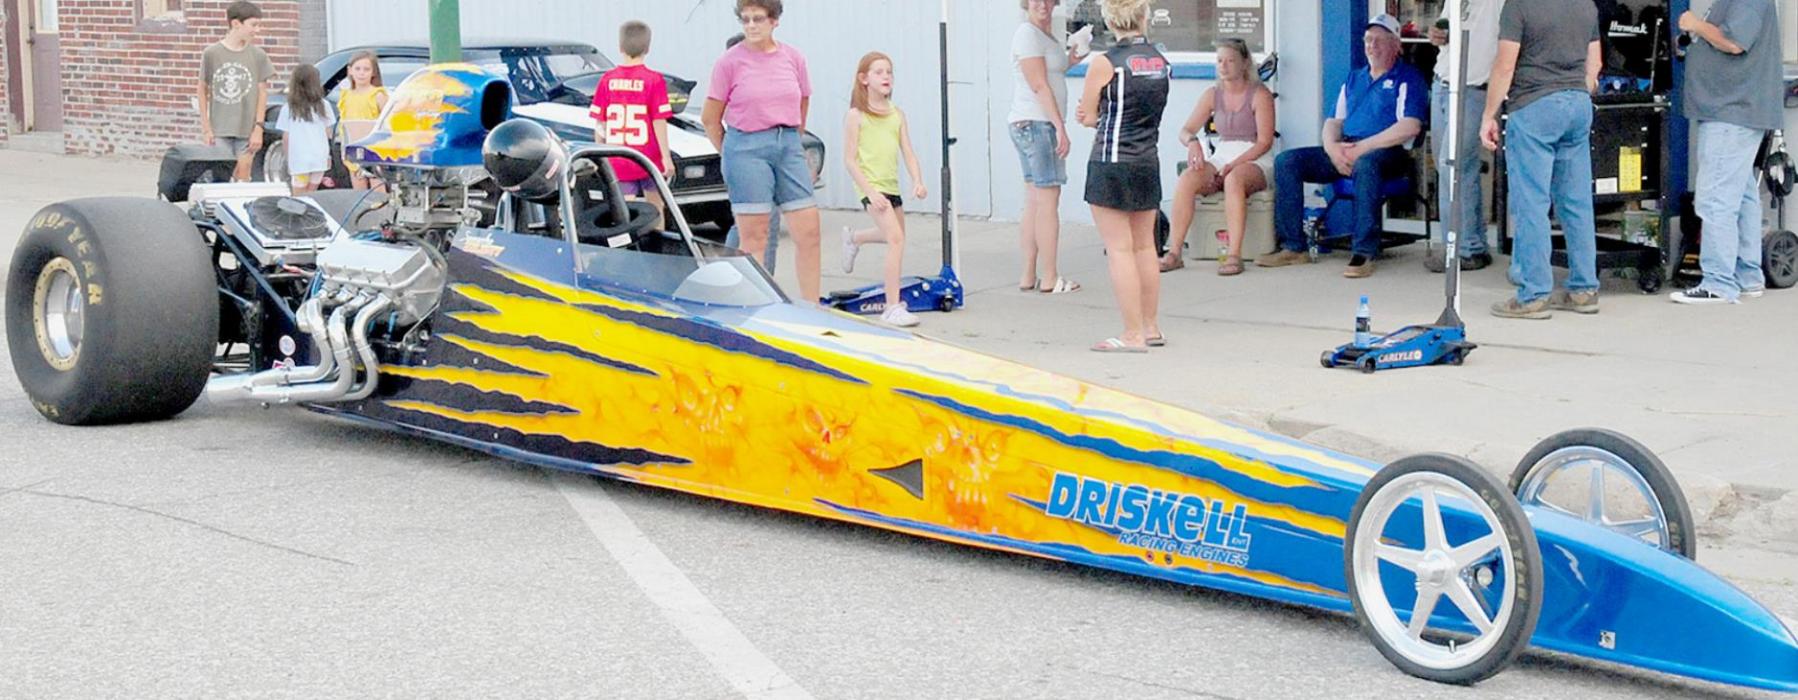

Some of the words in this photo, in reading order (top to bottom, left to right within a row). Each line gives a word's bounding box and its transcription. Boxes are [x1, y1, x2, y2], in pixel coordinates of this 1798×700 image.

[608, 78, 644, 92] CHARLES
[606, 103, 649, 145] 25
[1378, 350, 1415, 363] CARLYLE
[1118, 531, 1178, 553] RACING
[1179, 542, 1250, 568] ENGINES
